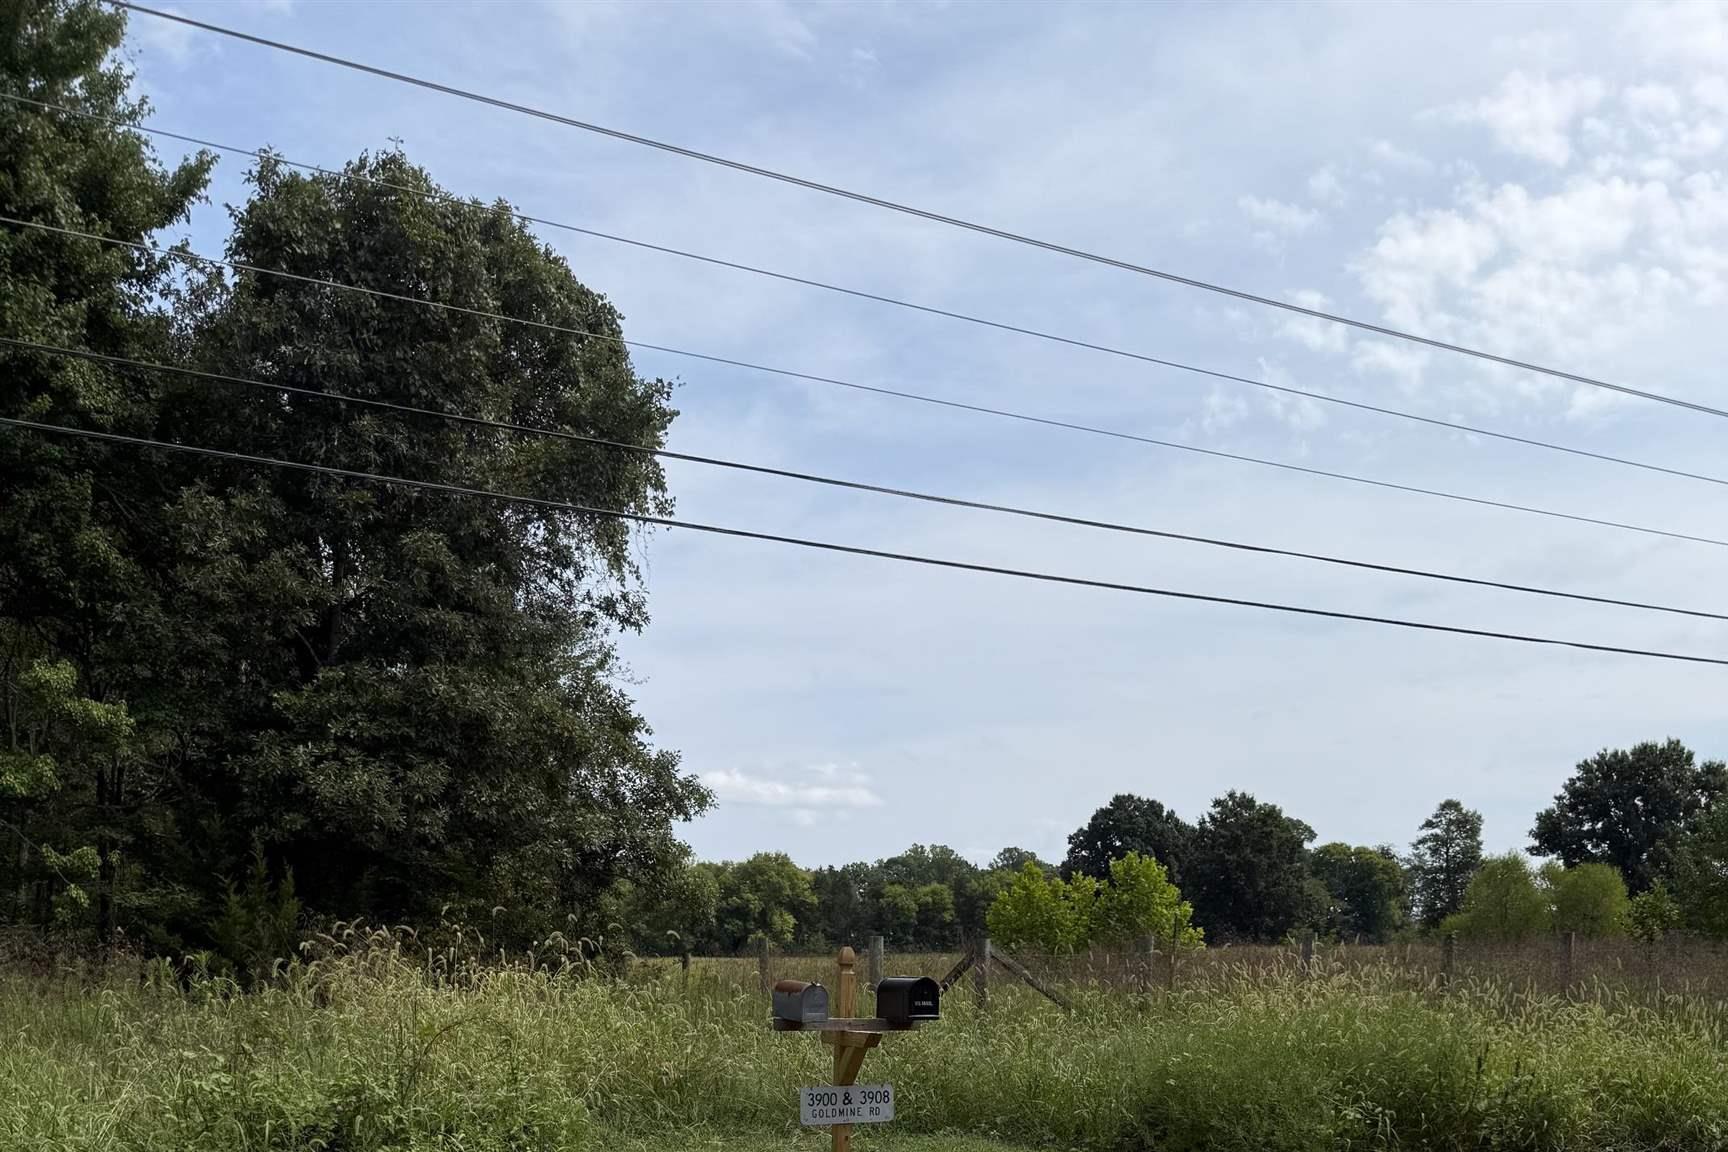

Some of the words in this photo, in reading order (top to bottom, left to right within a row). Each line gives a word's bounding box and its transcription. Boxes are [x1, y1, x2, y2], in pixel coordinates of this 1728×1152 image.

[808, 1092, 838, 1107] 3900
[842, 1091, 853, 1105] &
[860, 1090, 890, 1104] 3908
[812, 1107, 862, 1118] GOLDMINE
[869, 1107, 881, 1116] RD
